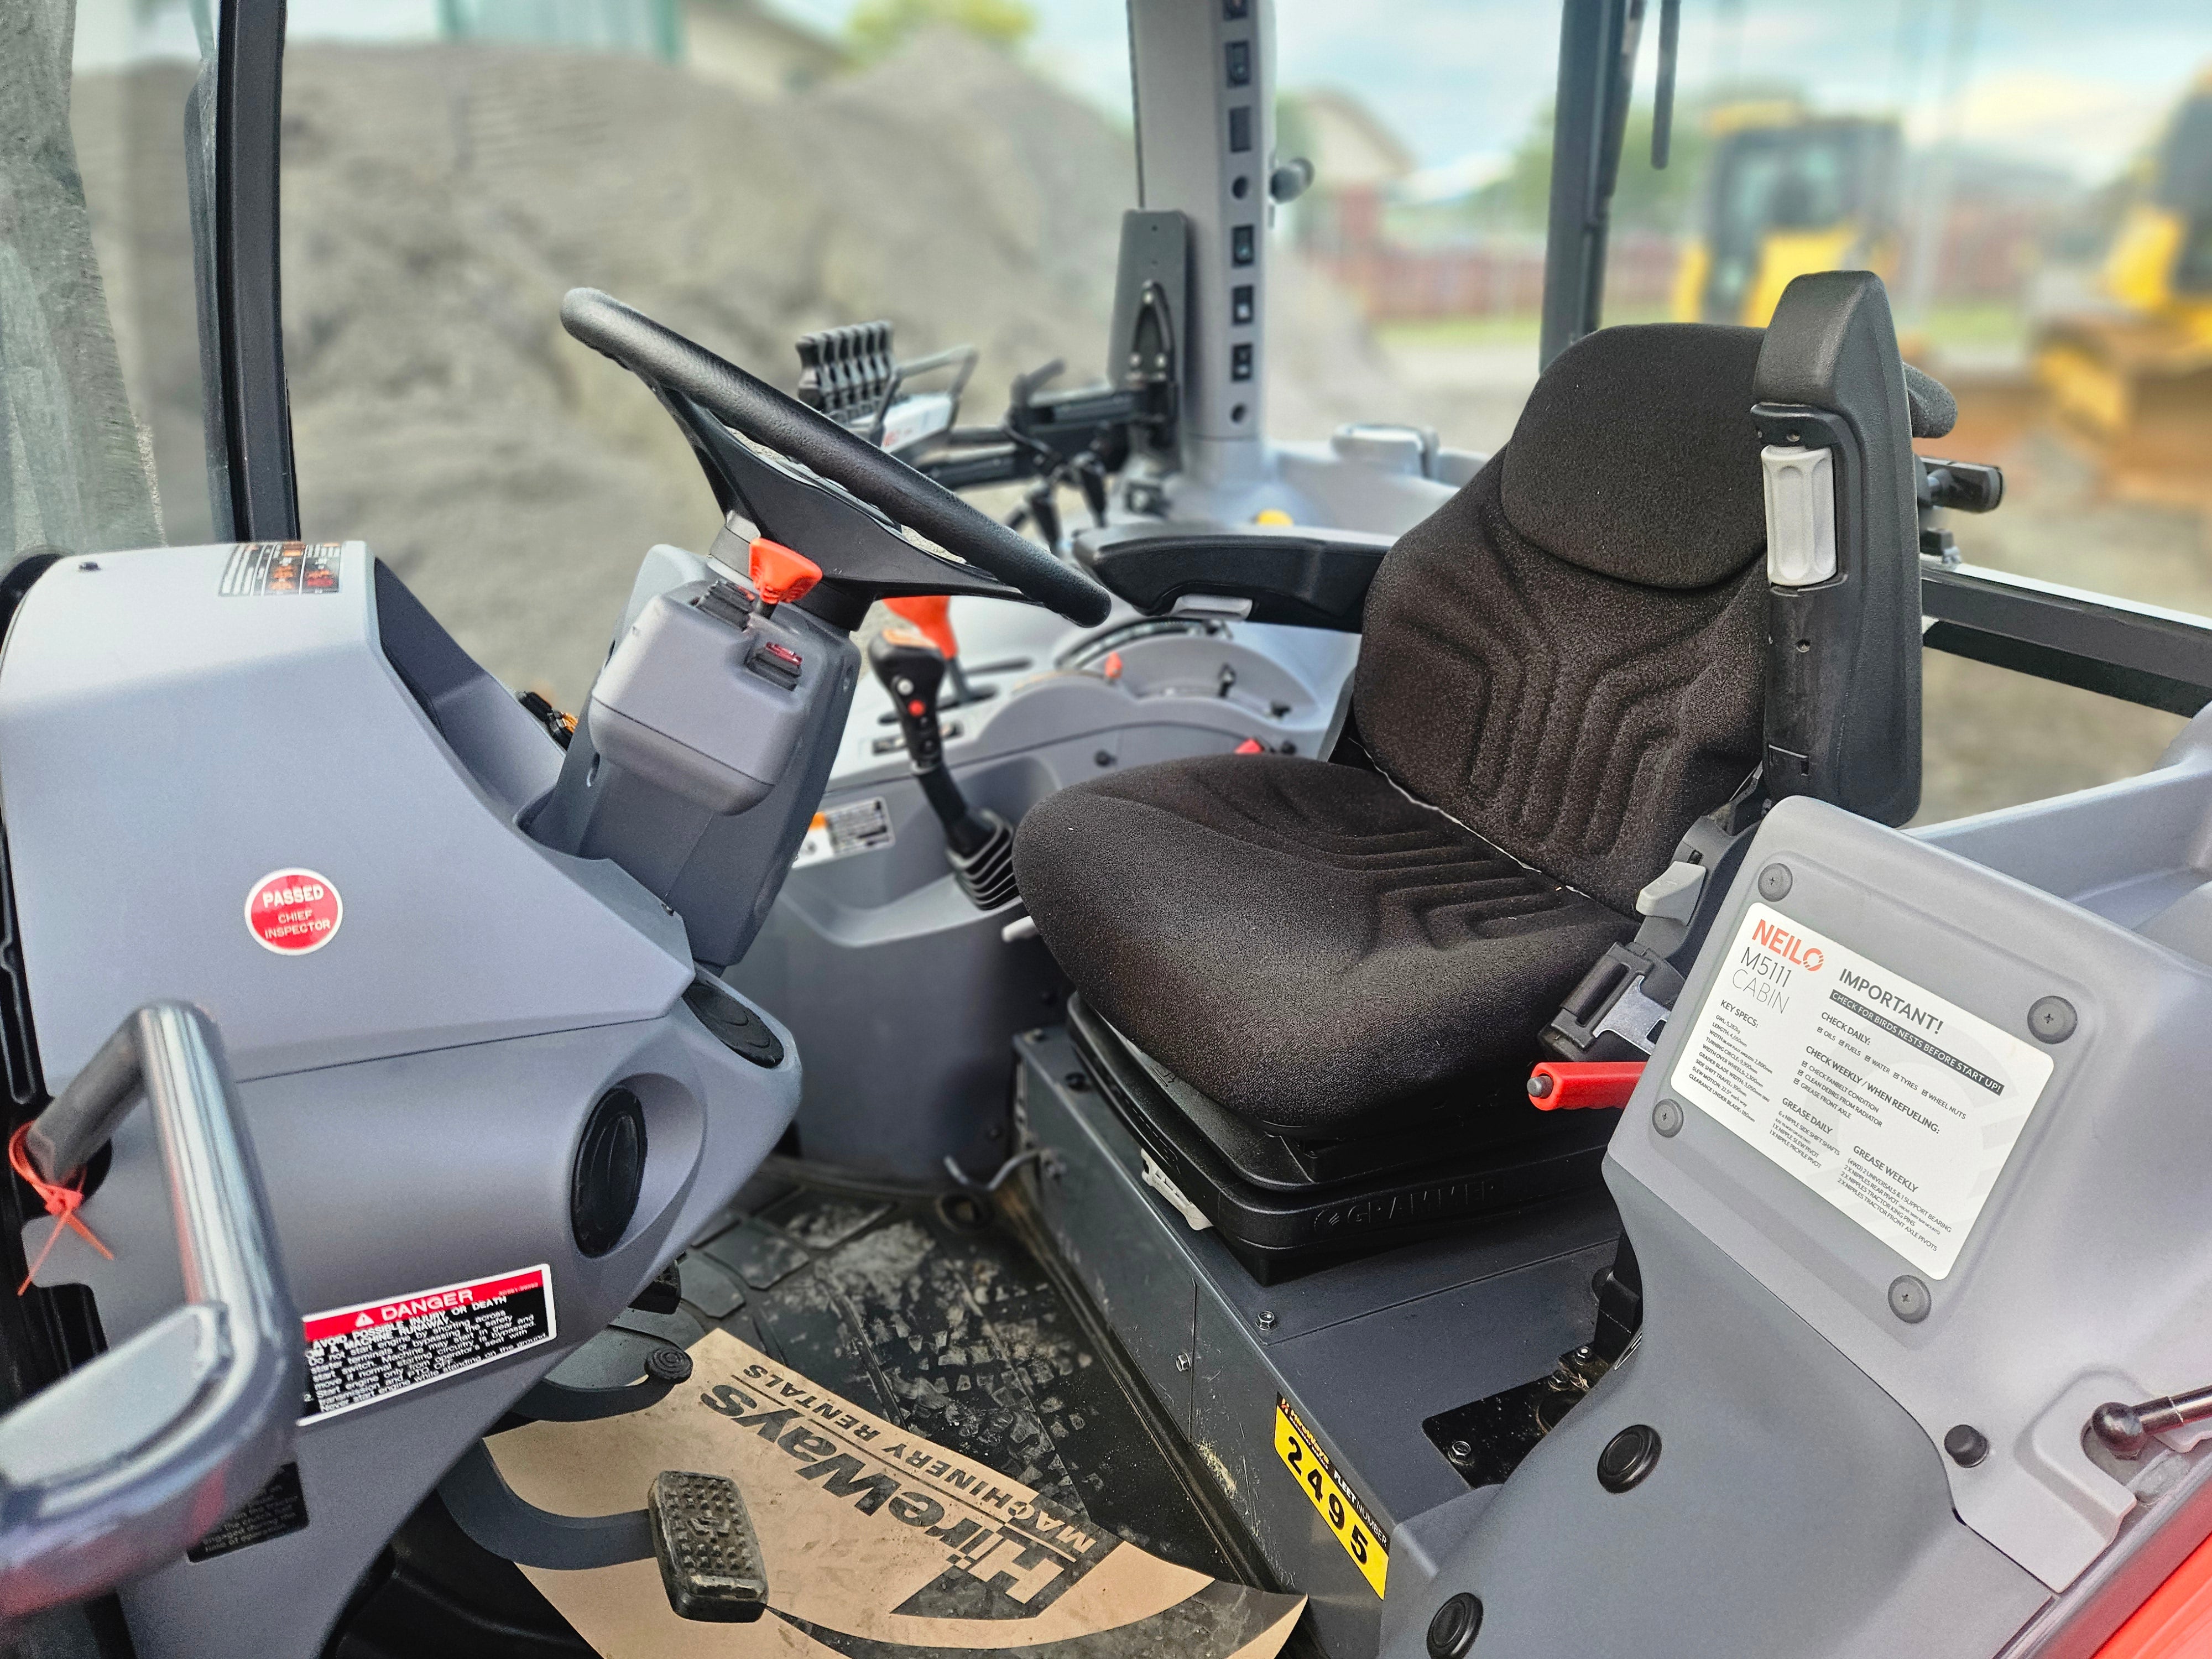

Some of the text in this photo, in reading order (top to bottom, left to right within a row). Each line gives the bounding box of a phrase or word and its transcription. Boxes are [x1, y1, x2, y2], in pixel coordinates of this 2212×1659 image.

[262, 884, 324, 908] PASSED
[264, 918, 331, 939] INSPECTOR
[278, 909, 313, 924] CHIEF
[1752, 919, 1824, 971] NEILO
[1740, 946, 1792, 987] M5111
[1732, 969, 1790, 1014] CABIN
[1839, 968, 1943, 1034] IMPORTANT!
[1712, 1021, 1729, 1036] LENGTH:
[1720, 999, 1759, 1028] KEY SPECS:
[1821, 1011, 1871, 1045] CHECK DAILY:
[1705, 1036, 1725, 1052] TURNING
[1724, 1048, 1740, 1062] CIRCLE:
[1709, 1029, 1724, 1041] WIDTH
[1823, 1030, 1836, 1041] OILS
[1832, 992, 2001, 1092] CHECK FOR BIRDS NESTS BEFORE START UP!
[1844, 1042, 1861, 1056] FUELS
[1692, 1066, 1704, 1076] SLEW
[1703, 1073, 1721, 1089] MOTION:
[1695, 1058, 1705, 1068] SIDE
[1704, 1065, 1717, 1076] SHIFT
[1716, 1072, 1733, 1087] TRAVEL:
[1699, 1051, 1716, 1066] GRADER
[1715, 1062, 1729, 1074] BLADE
[1729, 1071, 1744, 1085] WIDTH:
[1702, 1044, 1717, 1056] WIDTH
[1715, 1053, 1728, 1064] OVER
[1728, 1060, 1745, 1076] WHEELS:
[1871, 1058, 1890, 1074] WATER
[1688, 1073, 1713, 1092] CLEARANCE
[1712, 1089, 1727, 1103] UNDER
[1726, 1099, 1741, 1113] BLADE:
[1801, 1082, 1852, 1119] GREASE FRONT AXLE
[1804, 1074, 1882, 1127] CLEAN DEBRIS FROM RADIATOR
[1806, 1045, 1832, 1066] CHECK
[1832, 1061, 1863, 1084] WEEKLY
[1867, 1082, 1892, 1103] WHEN
[1891, 1098, 1940, 1134] REFUELING:
[1808, 1065, 1879, 1113] CHECK FANBELT CONDITION
[1900, 1076, 1918, 1091] TYRES
[1782, 1097, 1811, 1121] GREASE
[1809, 1115, 1833, 1134] DAILY
[1928, 1093, 1966, 1119] WHEEL NUTS
[1853, 1145, 1918, 1192] GREASE WEEKLY
[1847, 1157, 1864, 1172] (4WD)
[1866, 1171, 1897, 1194] UNIVERSALS
[1903, 1197, 1929, 1216] SUPPORT
[1927, 1213, 1952, 1233] BEARING
[1848, 1176, 1868, 1193] NIPPLES
[1867, 1189, 1891, 1209] TRACTOR
[1890, 1206, 1904, 1218] KING
[1903, 1215, 1916, 1227] PINS
[1851, 1170, 1871, 1186] NIPPLES
[1870, 1182, 1884, 1195] REAR
[1882, 1192, 1900, 1205] PIVOT
[1844, 1182, 1864, 1199] NIPPLES
[1864, 1196, 1888, 1216] TRACTOR
[1886, 1212, 1906, 1228] FRONT
[1904, 1225, 1919, 1238] AXLE
[1917, 1235, 1938, 1251] PIVOTS
[312, 1295, 507, 1350] AVOID POSSIBLE INJURY OR DEATH
[381, 1289, 474, 1322] DANGER
[1290, 1409, 1329, 1464] HireWays
[742, 1364, 1097, 1554] MACHINERY RENTALS
[700, 1384, 1065, 1605] HireWays
[1287, 1436, 1368, 1565] 2495
[1334, 1469, 1387, 1548] FLEET NUMBER
